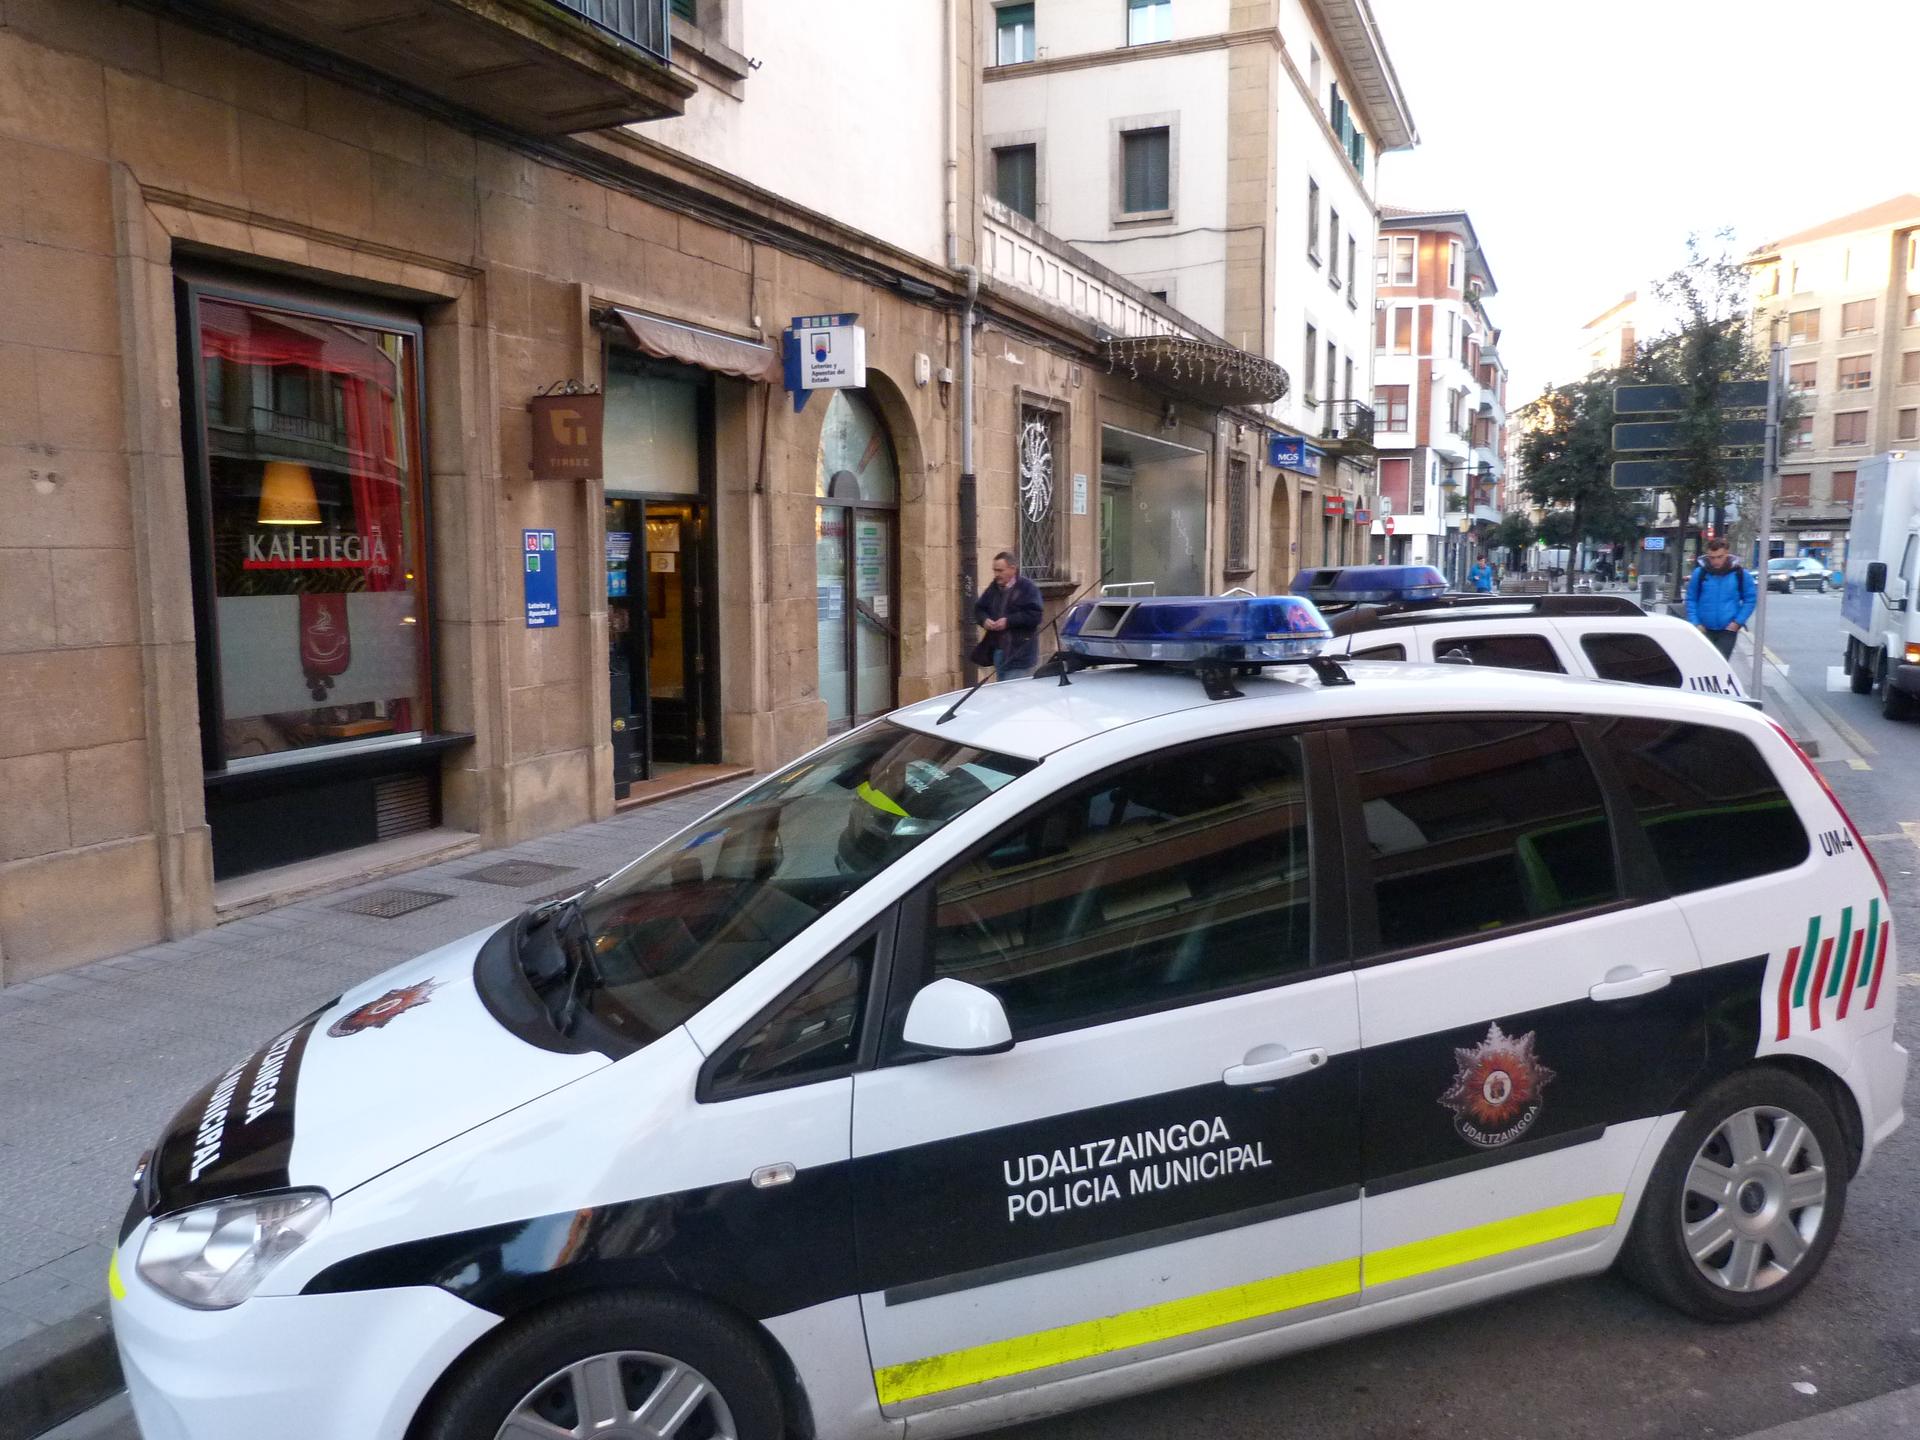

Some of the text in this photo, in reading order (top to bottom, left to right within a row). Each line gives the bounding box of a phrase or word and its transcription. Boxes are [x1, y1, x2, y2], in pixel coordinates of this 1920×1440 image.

[1277, 453, 1299, 461] MGS
[247, 534, 388, 562] KAFETEGIA
[1818, 826, 1854, 857] UM-4
[1462, 1105, 1538, 1144] UDALTZAINGOA
[1003, 1116, 1231, 1187] UDALTZAINGOA
[1007, 1141, 1273, 1223] POLICIA MUNICIPAL
